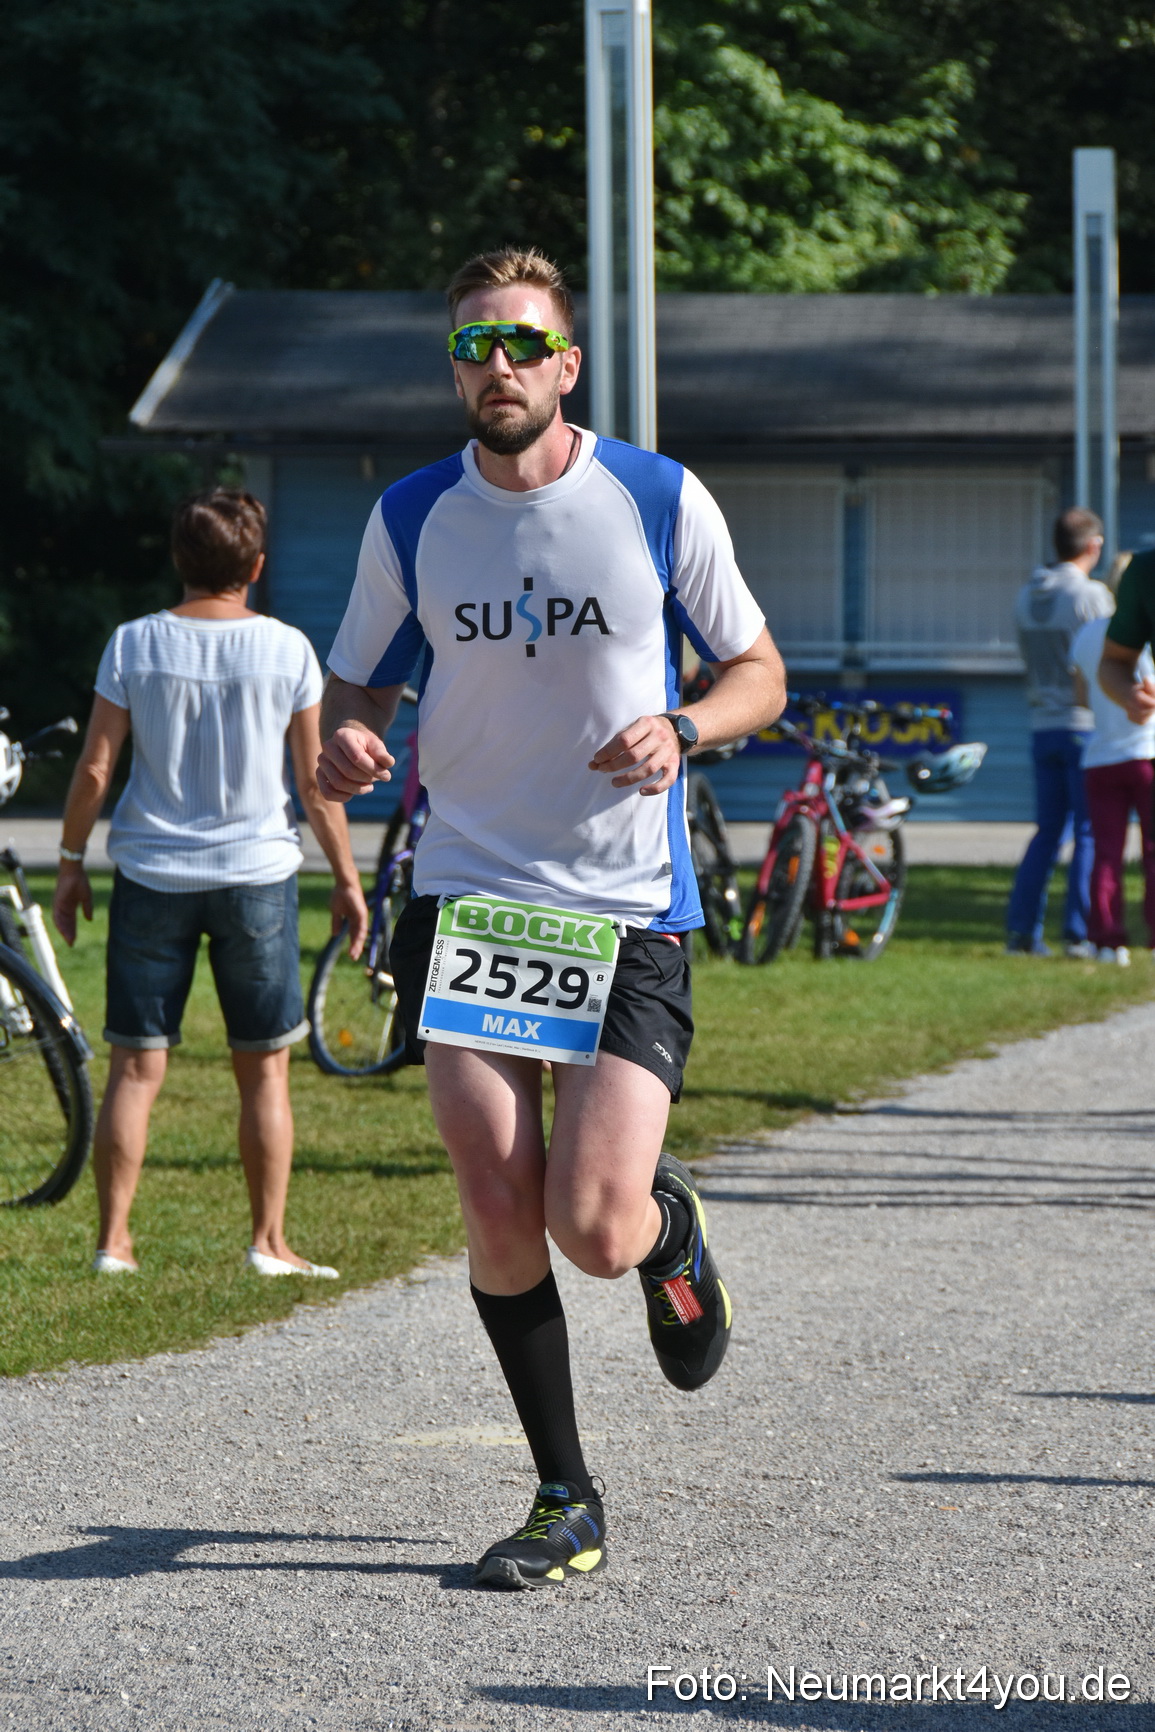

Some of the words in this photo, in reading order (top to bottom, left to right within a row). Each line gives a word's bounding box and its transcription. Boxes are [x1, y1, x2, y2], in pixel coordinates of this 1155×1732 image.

[455, 593, 610, 642] SUSPA
[452, 901, 604, 955] BOCK
[449, 948, 590, 1010] 2529
[482, 1013, 542, 1040] MAX
